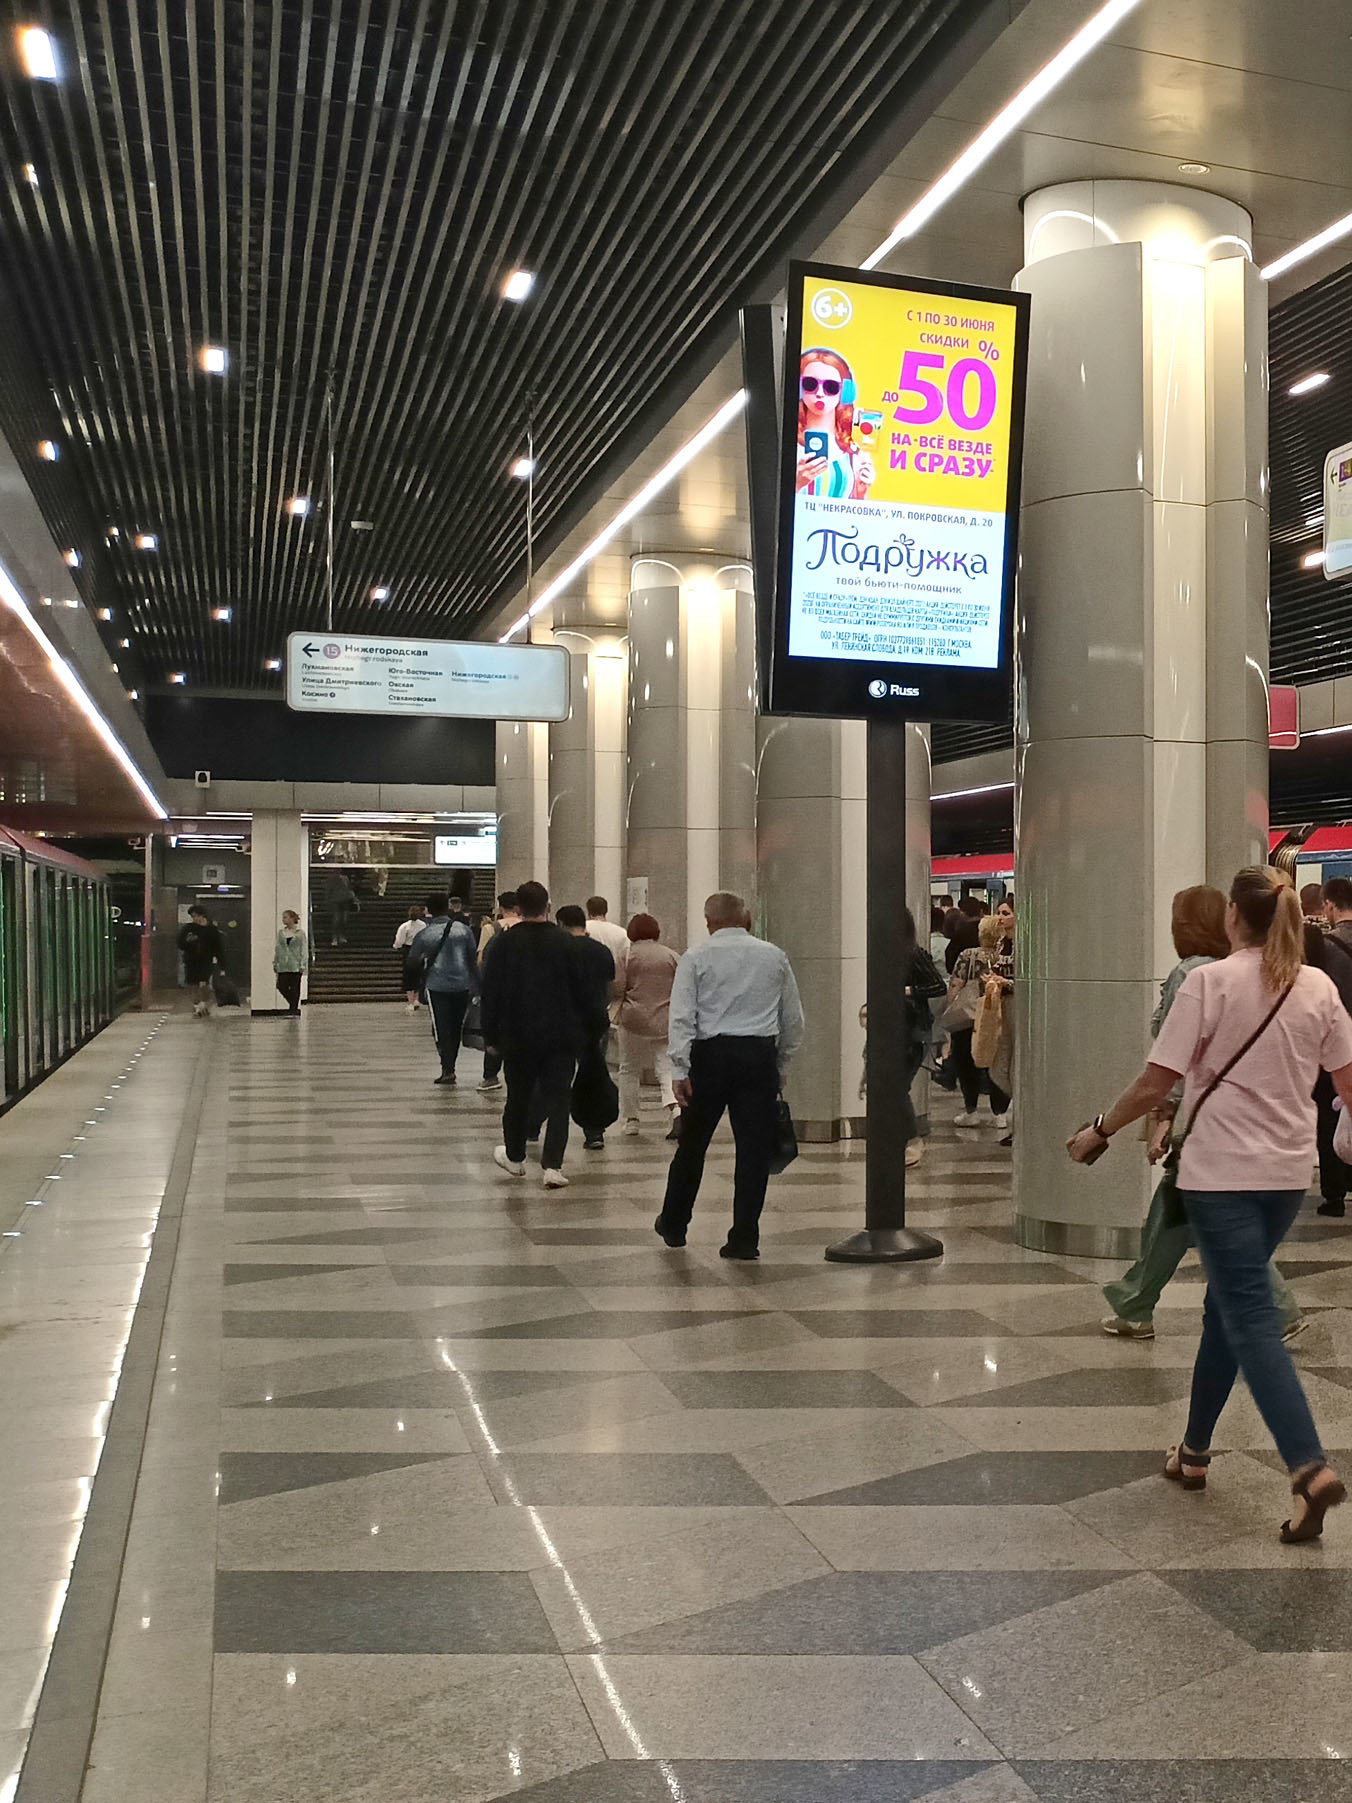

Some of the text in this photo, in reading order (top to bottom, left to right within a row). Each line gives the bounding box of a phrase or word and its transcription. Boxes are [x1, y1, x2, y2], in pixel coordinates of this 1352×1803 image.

[815, 295, 848, 319] 6+
[916, 311, 922, 322] 1
[925, 312, 941, 325] ПО
[943, 314, 958, 327] 30
[961, 317, 995, 332] ИЮНЯ
[919, 332, 969, 349] СКИДКИ
[978, 340, 1000, 361] %
[893, 350, 996, 431] 50
[891, 432, 912, 446] НА
[948, 439, 992, 456] ВЕЗДЕ
[890, 449, 907, 470] И
[805, 501, 817, 512] ТЦ
[982, 518, 993, 527] 20
[806, 525, 989, 579] Подружка
[836, 577, 962, 594] твой бьюти-помощник
[326, 646, 337, 656] 15
[345, 644, 428, 657] Нижегородская
[890, 684, 919, 696] Russ
